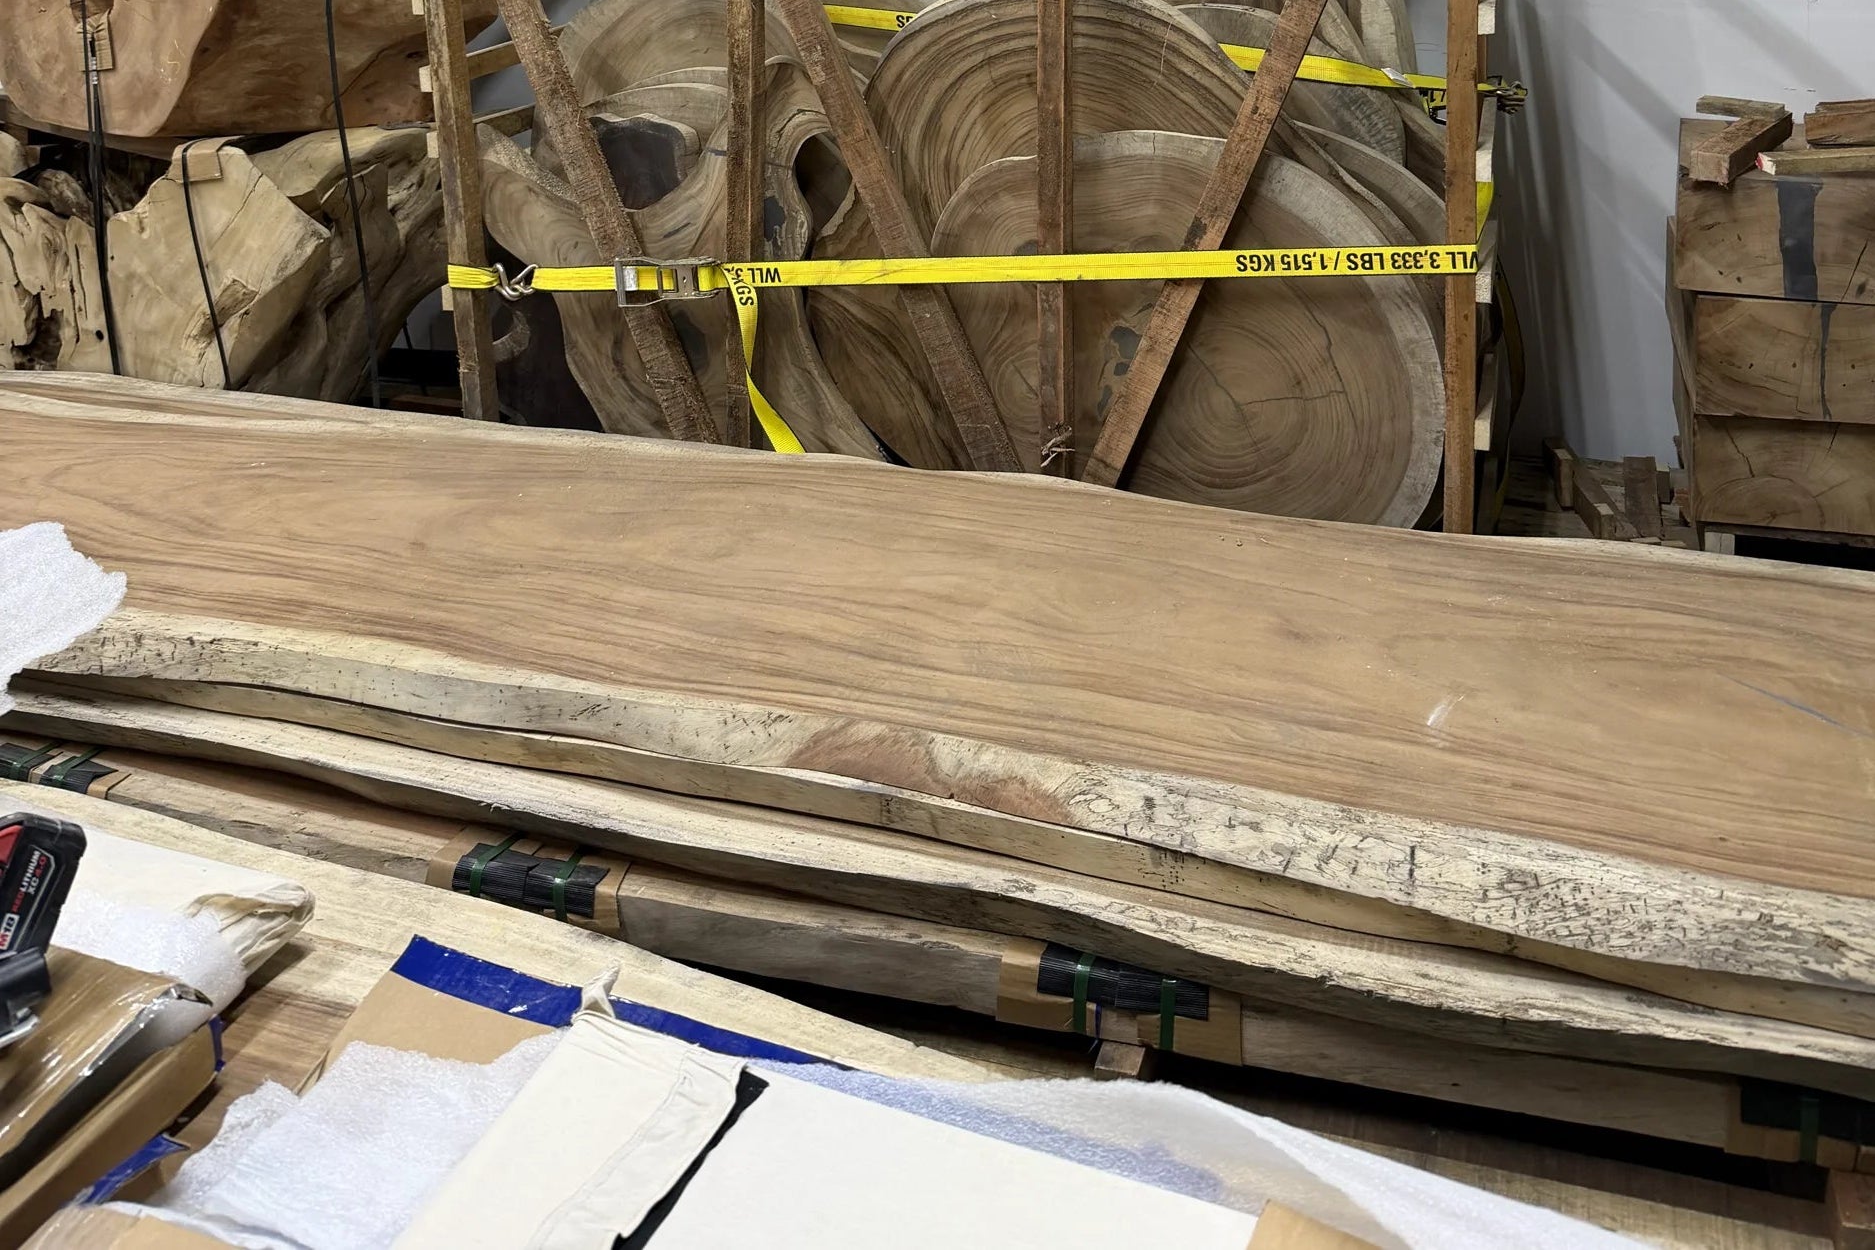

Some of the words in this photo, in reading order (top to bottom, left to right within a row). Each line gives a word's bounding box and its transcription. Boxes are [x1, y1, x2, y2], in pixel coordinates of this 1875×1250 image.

[1236, 254, 1276, 272] KGS
[1280, 252, 1329, 271] 1,515
[1334, 251, 1341, 270] /
[1346, 252, 1384, 270] LBS
[1391, 250, 1441, 269] 3,333
[747, 267, 781, 283] WLL
[731, 277, 755, 306] KGS
